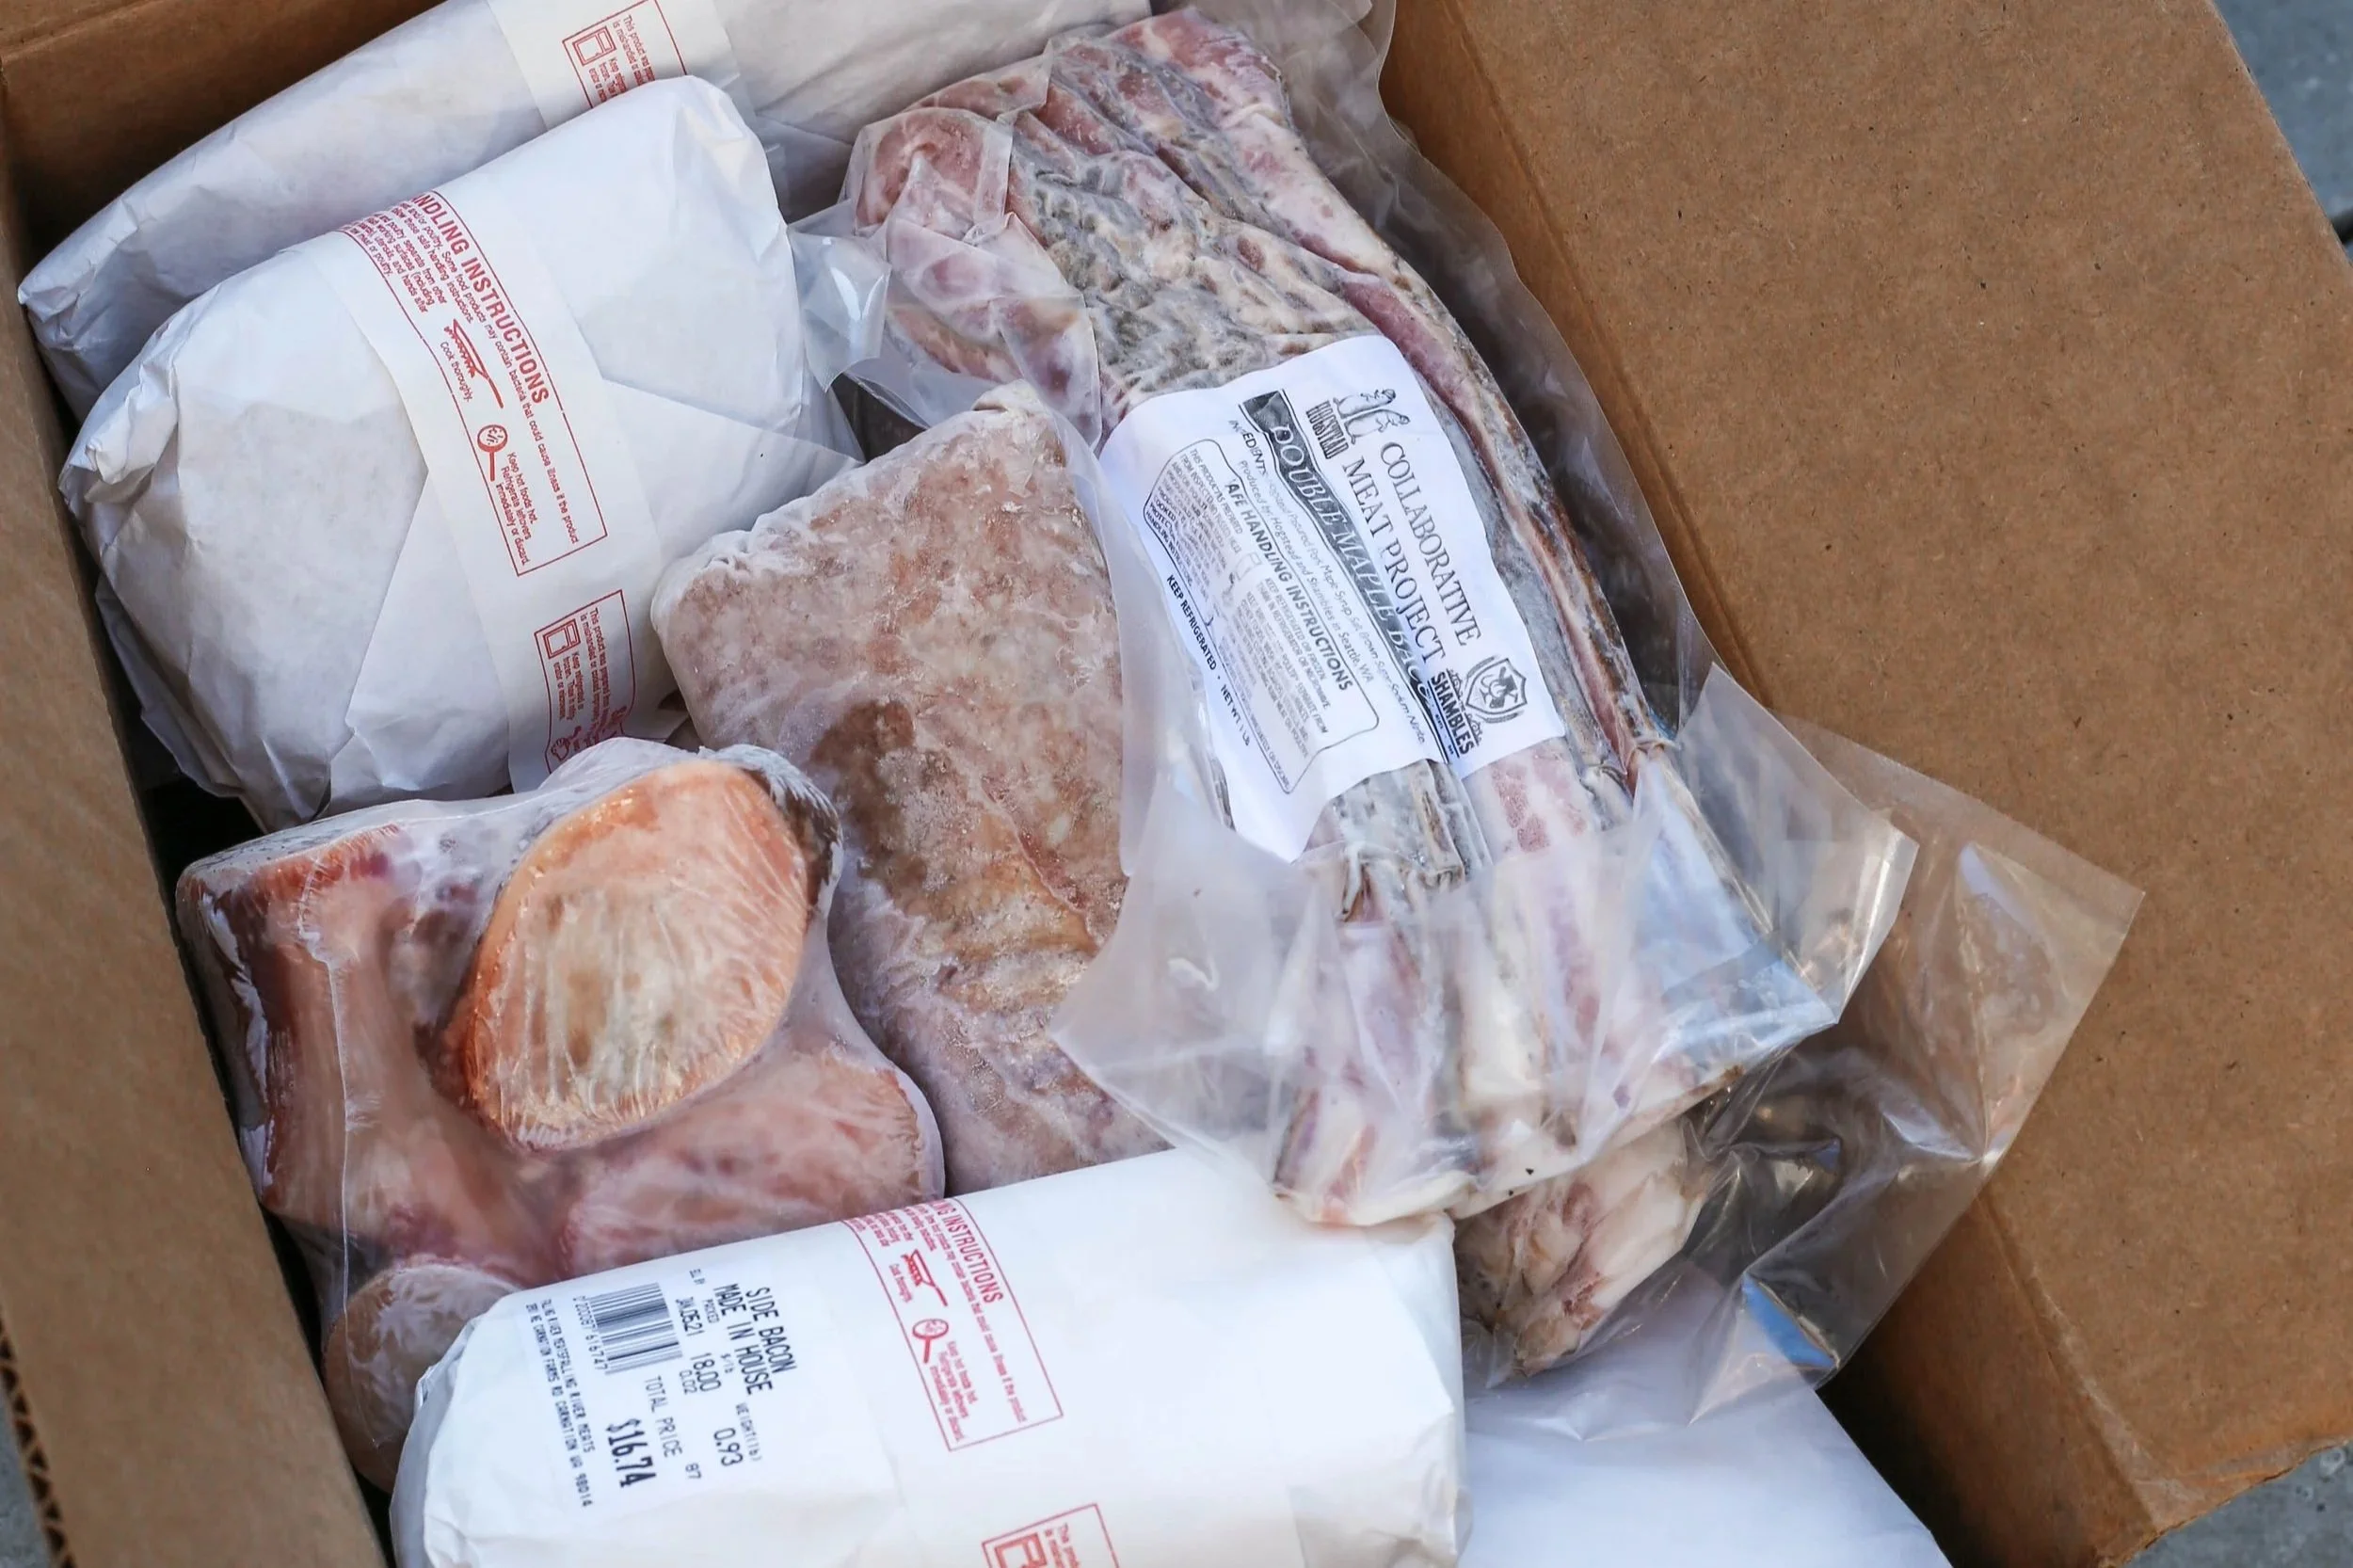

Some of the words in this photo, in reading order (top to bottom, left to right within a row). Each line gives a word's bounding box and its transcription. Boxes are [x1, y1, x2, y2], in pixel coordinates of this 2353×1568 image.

[393, 243, 415, 271] surfaces
[403, 239, 425, 267] separate
[422, 267, 436, 285] from
[432, 286, 447, 304] other
[441, 250, 457, 273] Some
[392, 260, 406, 274] and
[401, 274, 418, 296] hands
[414, 296, 428, 312] after
[427, 248, 450, 281] handling
[446, 281, 474, 324] instructions.
[455, 273, 471, 291] food
[463, 292, 487, 323] products
[461, 257, 550, 404] INSTRUCTIONS
[484, 324, 497, 339] may
[495, 341, 512, 368] contain
[440, 341, 456, 360] Cook
[451, 361, 472, 403] thoroughly.
[508, 369, 527, 401] bacteria
[522, 402, 535, 419] that
[529, 420, 543, 441] could
[1305, 400, 1350, 459] HOGSTEAD
[506, 452, 520, 472] Keep
[537, 443, 552, 466] cause
[516, 472, 525, 488] hot
[501, 465, 520, 508] Refrigerate
[516, 507, 532, 540] leftovers
[520, 487, 532, 508] foods
[558, 500, 568, 514] the
[511, 527, 520, 536] or
[527, 508, 538, 524] hot.
[562, 515, 579, 544] product
[1267, 419, 1347, 525] DOUBLE
[1330, 524, 1396, 621] MAPLE
[1342, 456, 1393, 538] MEAT
[1383, 538, 1446, 664] PROJECT
[1380, 442, 1481, 646] COLLABORATIVE
[1225, 479, 1247, 506] AFE
[1241, 510, 1292, 582] HANDLING
[1286, 585, 1353, 691] INSTRUCTIONS
[1238, 459, 1265, 504] Produced
[1271, 517, 1302, 560] Hogstead
[1358, 664, 1374, 682] WA
[1167, 574, 1184, 599] KEEP
[1180, 599, 1217, 670] REFRIGERATED
[1221, 684, 1233, 706] NET
[1431, 671, 1475, 755] SHAMBLES
[942, 1214, 1003, 1304] INSTRUCTIONS
[714, 1284, 746, 1316] MADE
[745, 1288, 778, 1321] SIDE
[727, 1321, 755, 1340] IN
[585, 1335, 608, 1369] 616747
[758, 1326, 796, 1374] BACON
[679, 1369, 697, 1395] 0.02
[691, 1352, 722, 1392] 18.00
[735, 1344, 772, 1395] HOUSE
[569, 1391, 585, 1419] RIVER
[646, 1375, 666, 1413] TOTAL
[657, 1416, 682, 1457] PRICE
[606, 1419, 657, 1488] $16.74
[713, 1428, 744, 1466] 0.93
[685, 1463, 702, 1479] 87
